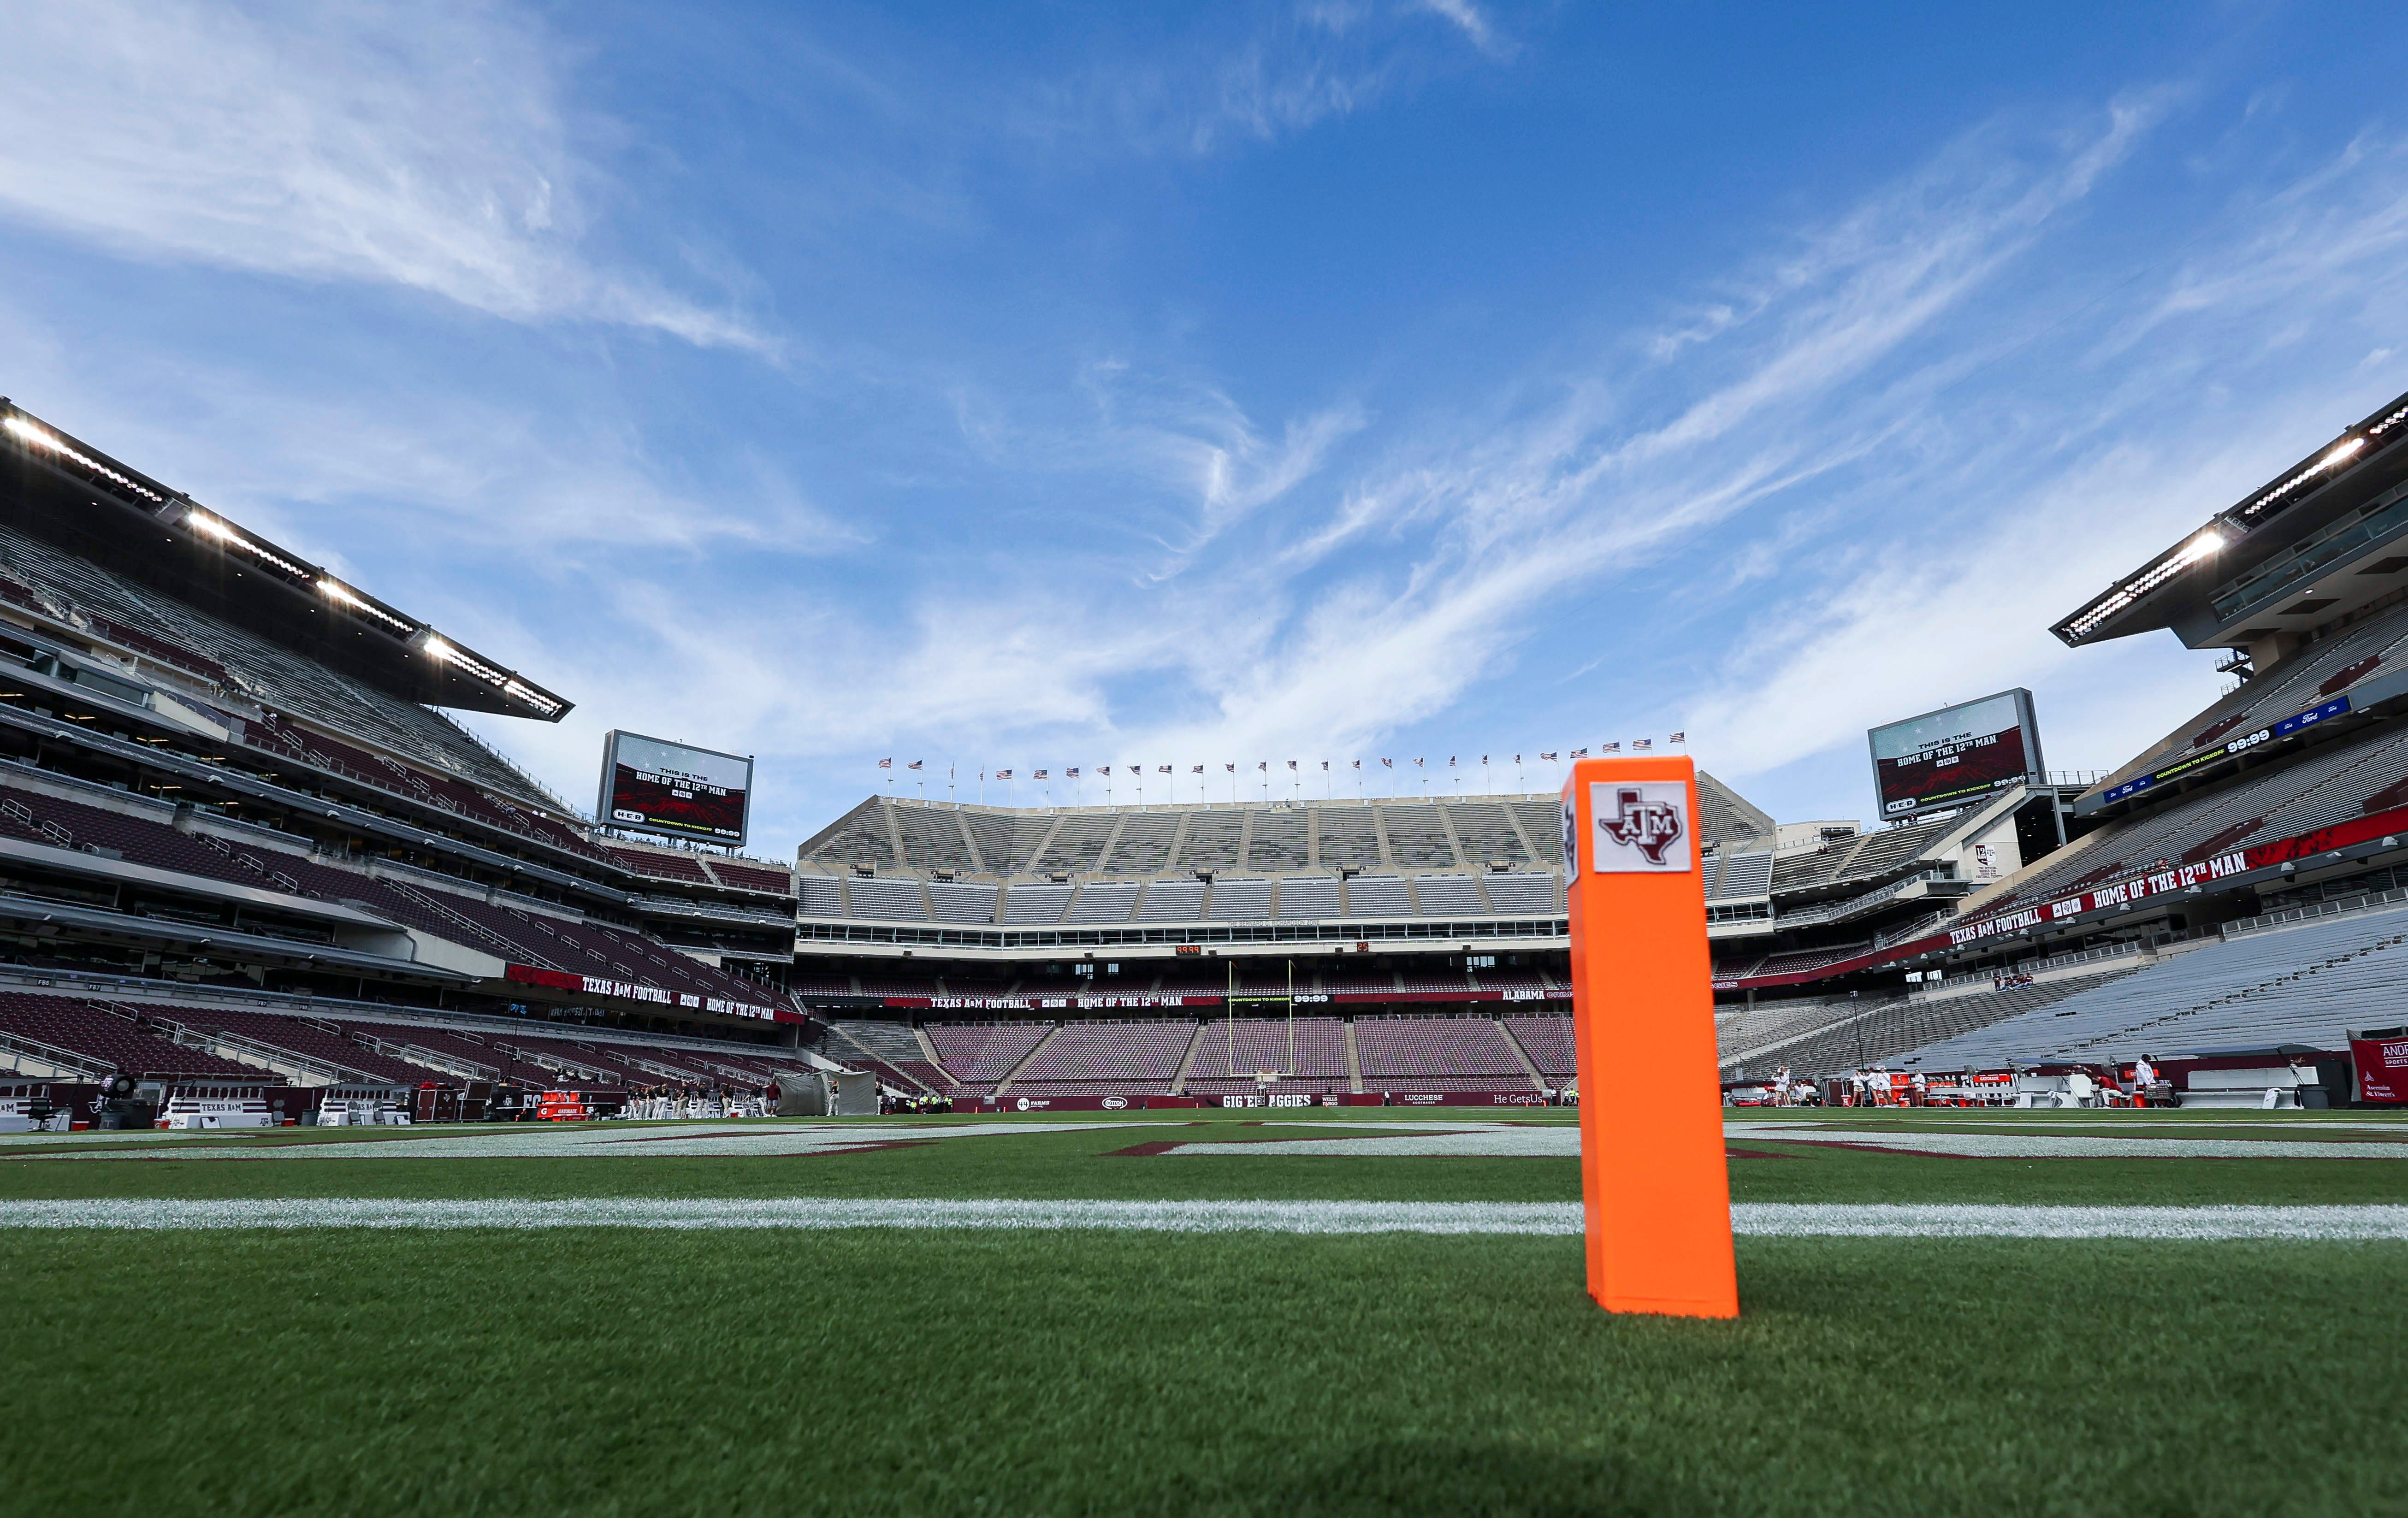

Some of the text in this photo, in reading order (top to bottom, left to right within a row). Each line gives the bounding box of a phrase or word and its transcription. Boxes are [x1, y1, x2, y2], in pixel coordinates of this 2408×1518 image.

[2302, 713, 2318, 724] Ford
[1918, 740, 1940, 750] THIS
[1952, 732, 1972, 740] THE
[2227, 729, 2270, 753] 99:99
[1897, 755, 1921, 767] HOME
[1923, 751, 1934, 761] OF
[1936, 746, 1954, 757] THE
[1956, 741, 1973, 752] 12TH
[2156, 762, 2192, 779] COUNTDOWN
[2200, 749, 2225, 762] KICKOFF
[636, 771, 659, 783] HOME
[662, 776, 672, 785] OF
[674, 779, 690, 789] THE
[692, 783, 707, 791] 12TH
[1921, 791, 1957, 802] COUNTDOWN
[1966, 784, 1991, 792] KICKOFF
[2122, 785, 2133, 794] Ford
[649, 818, 683, 827] COUNTDOWN
[714, 828, 740, 837] 99:99
[2093, 884, 2128, 909] HOME
[2129, 879, 2145, 899] OF
[2148, 872, 2177, 894] THE
[2178, 862, 2207, 886] 12TH
[1950, 909, 2041, 945] TEXAS A&M FOOTBALL
[1357, 943, 1367, 951] 25
[583, 977, 671, 1004] TEXAS A&M FOOTBALL
[1503, 991, 1545, 1000] ALABAMA
[706, 998, 725, 1013] HOME
[726, 1001, 734, 1014] OF
[735, 1003, 748, 1016] THE
[749, 1005, 760, 1017] 12TH
[931, 998, 1030, 1008] TEXAS A&M FOOTBALL
[1077, 998, 1103, 1007] HOME
[1106, 998, 1117, 1007] OF
[1120, 998, 1138, 1007] THE
[1141, 997, 1159, 1006] 12TH
[1223, 1095, 1311, 1108] GIG 'E AGGIES
[1494, 1094, 1507, 1103] He
